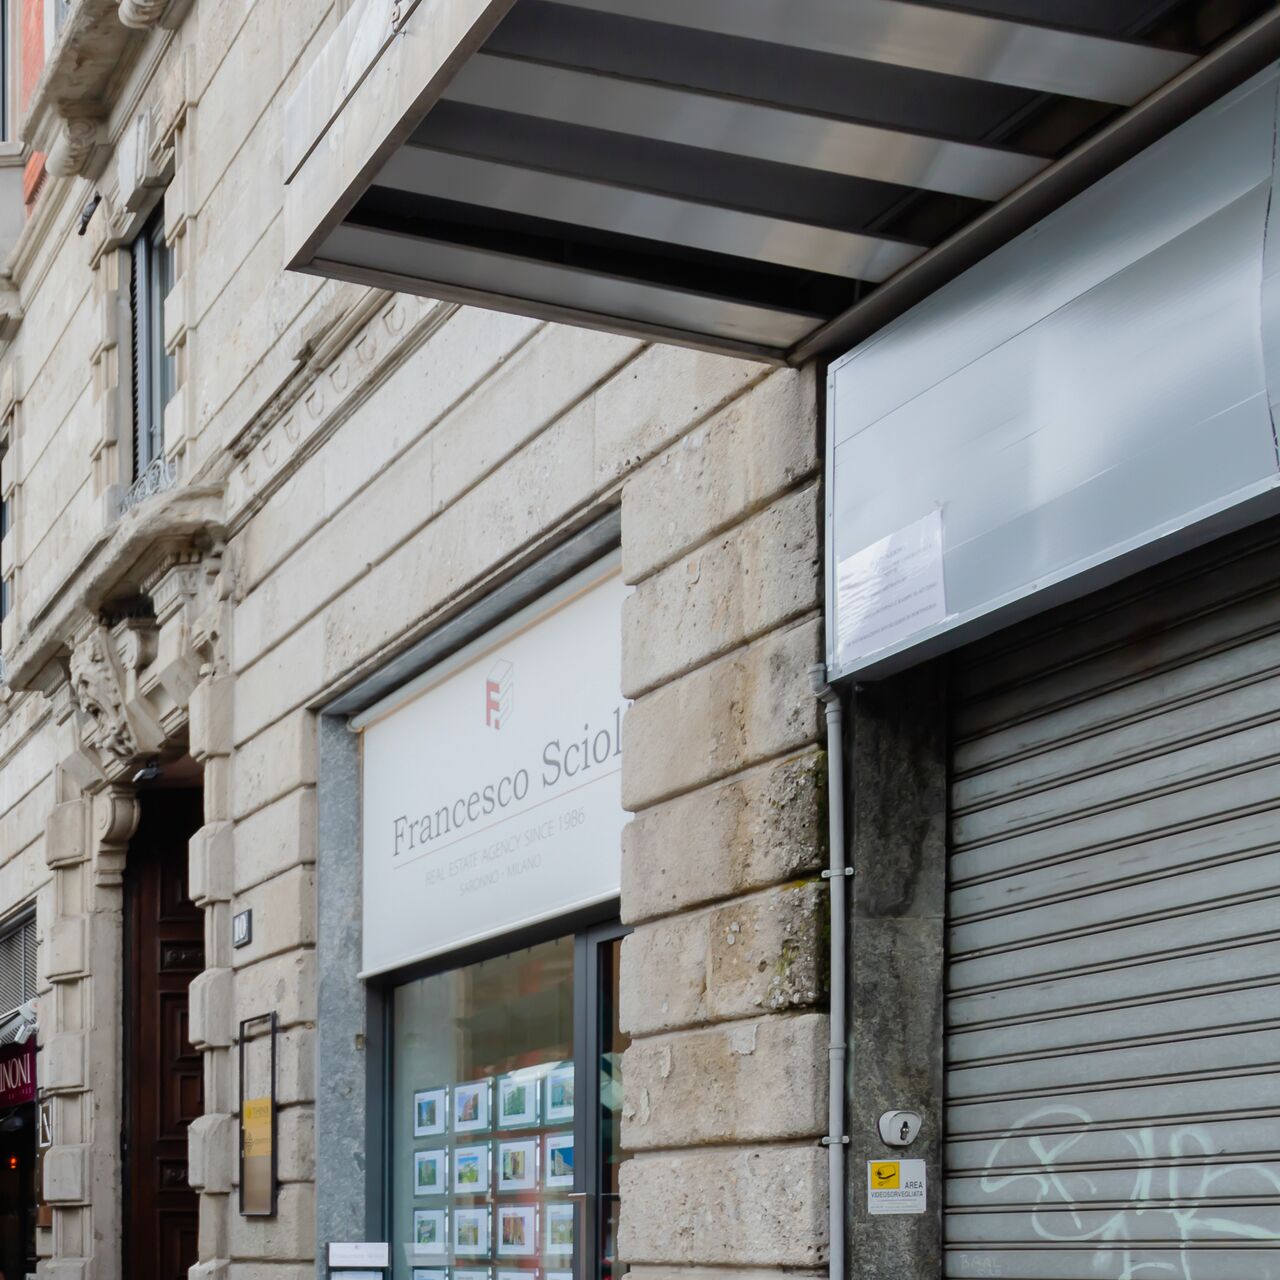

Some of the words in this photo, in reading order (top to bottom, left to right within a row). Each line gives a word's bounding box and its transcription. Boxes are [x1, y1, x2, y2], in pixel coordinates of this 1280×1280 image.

[393, 768, 529, 857] Francesco
[425, 866, 445, 888] REAL
[449, 852, 479, 878] ESTATE
[481, 834, 522, 864] AGENCY
[525, 819, 555, 847] SINCE
[559, 806, 586, 833] 1986
[506, 853, 543, 878] MILANO
[904, 1181, 923, 1189] AREA
